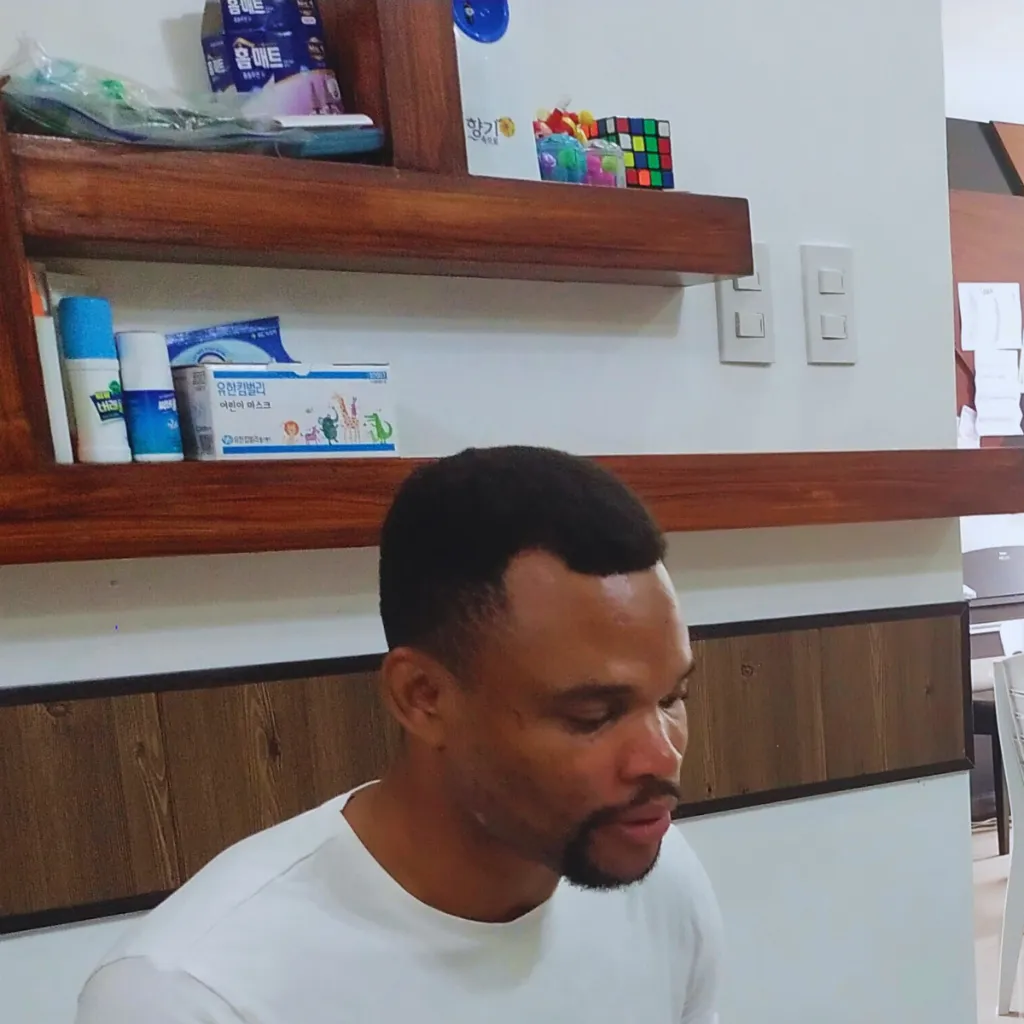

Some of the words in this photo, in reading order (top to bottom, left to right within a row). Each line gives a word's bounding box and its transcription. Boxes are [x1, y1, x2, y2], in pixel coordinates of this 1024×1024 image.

[233, 46, 284, 70] 홈매트
[465, 117, 498, 138] 향기
[216, 381, 267, 397] 유한킴벌리
[219, 400, 245, 413] 어린이
[246, 400, 272, 410] 마스크
